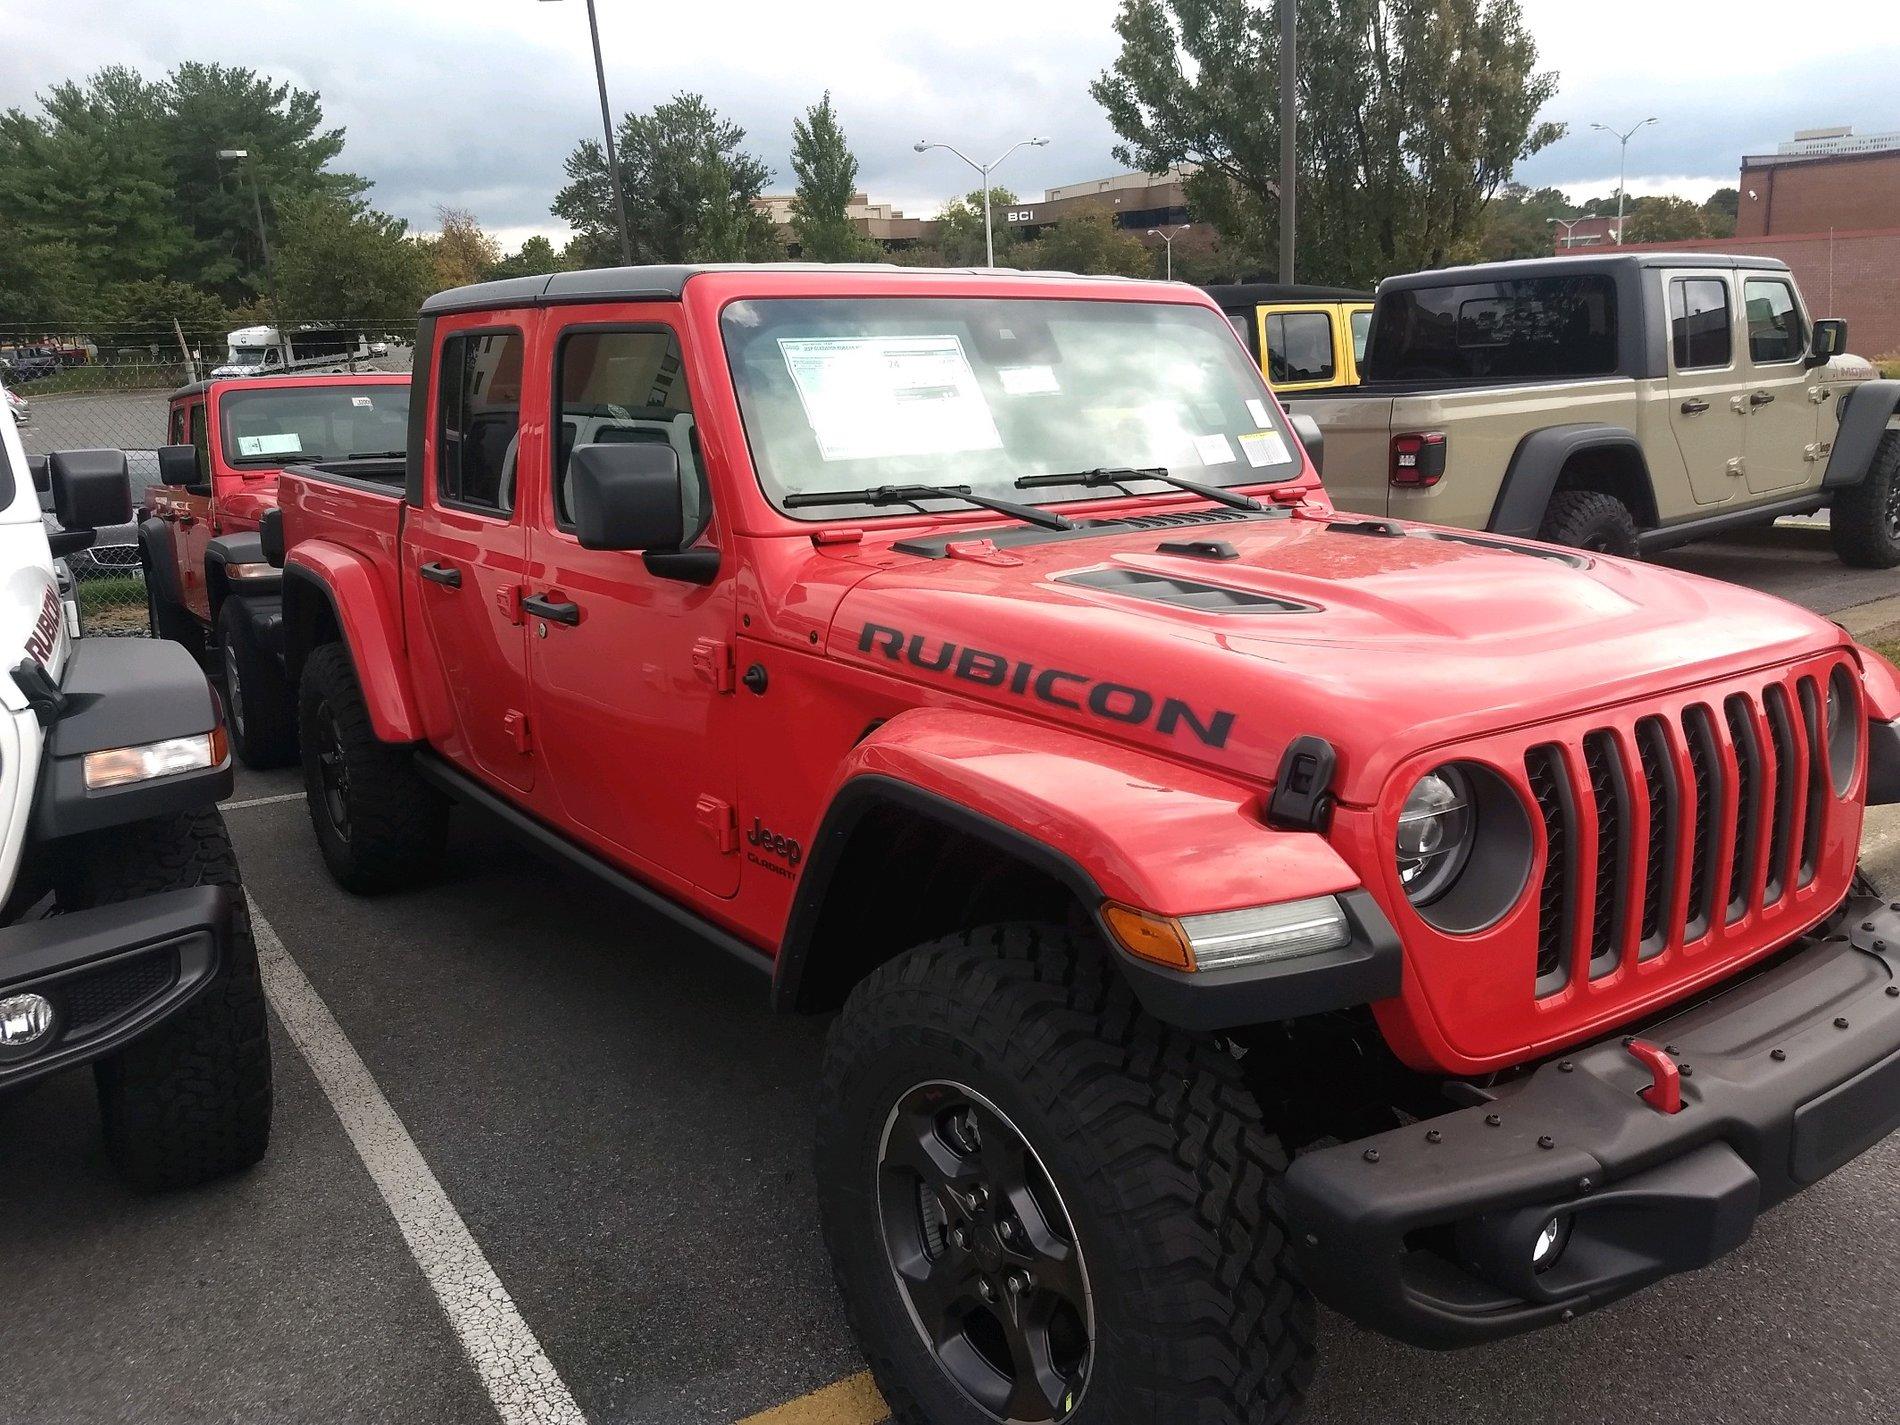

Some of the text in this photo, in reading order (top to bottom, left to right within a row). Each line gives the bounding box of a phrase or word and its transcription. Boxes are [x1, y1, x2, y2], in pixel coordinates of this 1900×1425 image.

[1008, 210, 1034, 221] BCI
[857, 621, 1236, 749] RUBICON
[747, 816, 801, 868] Jeep
[747, 851, 797, 881] GLADIAT
